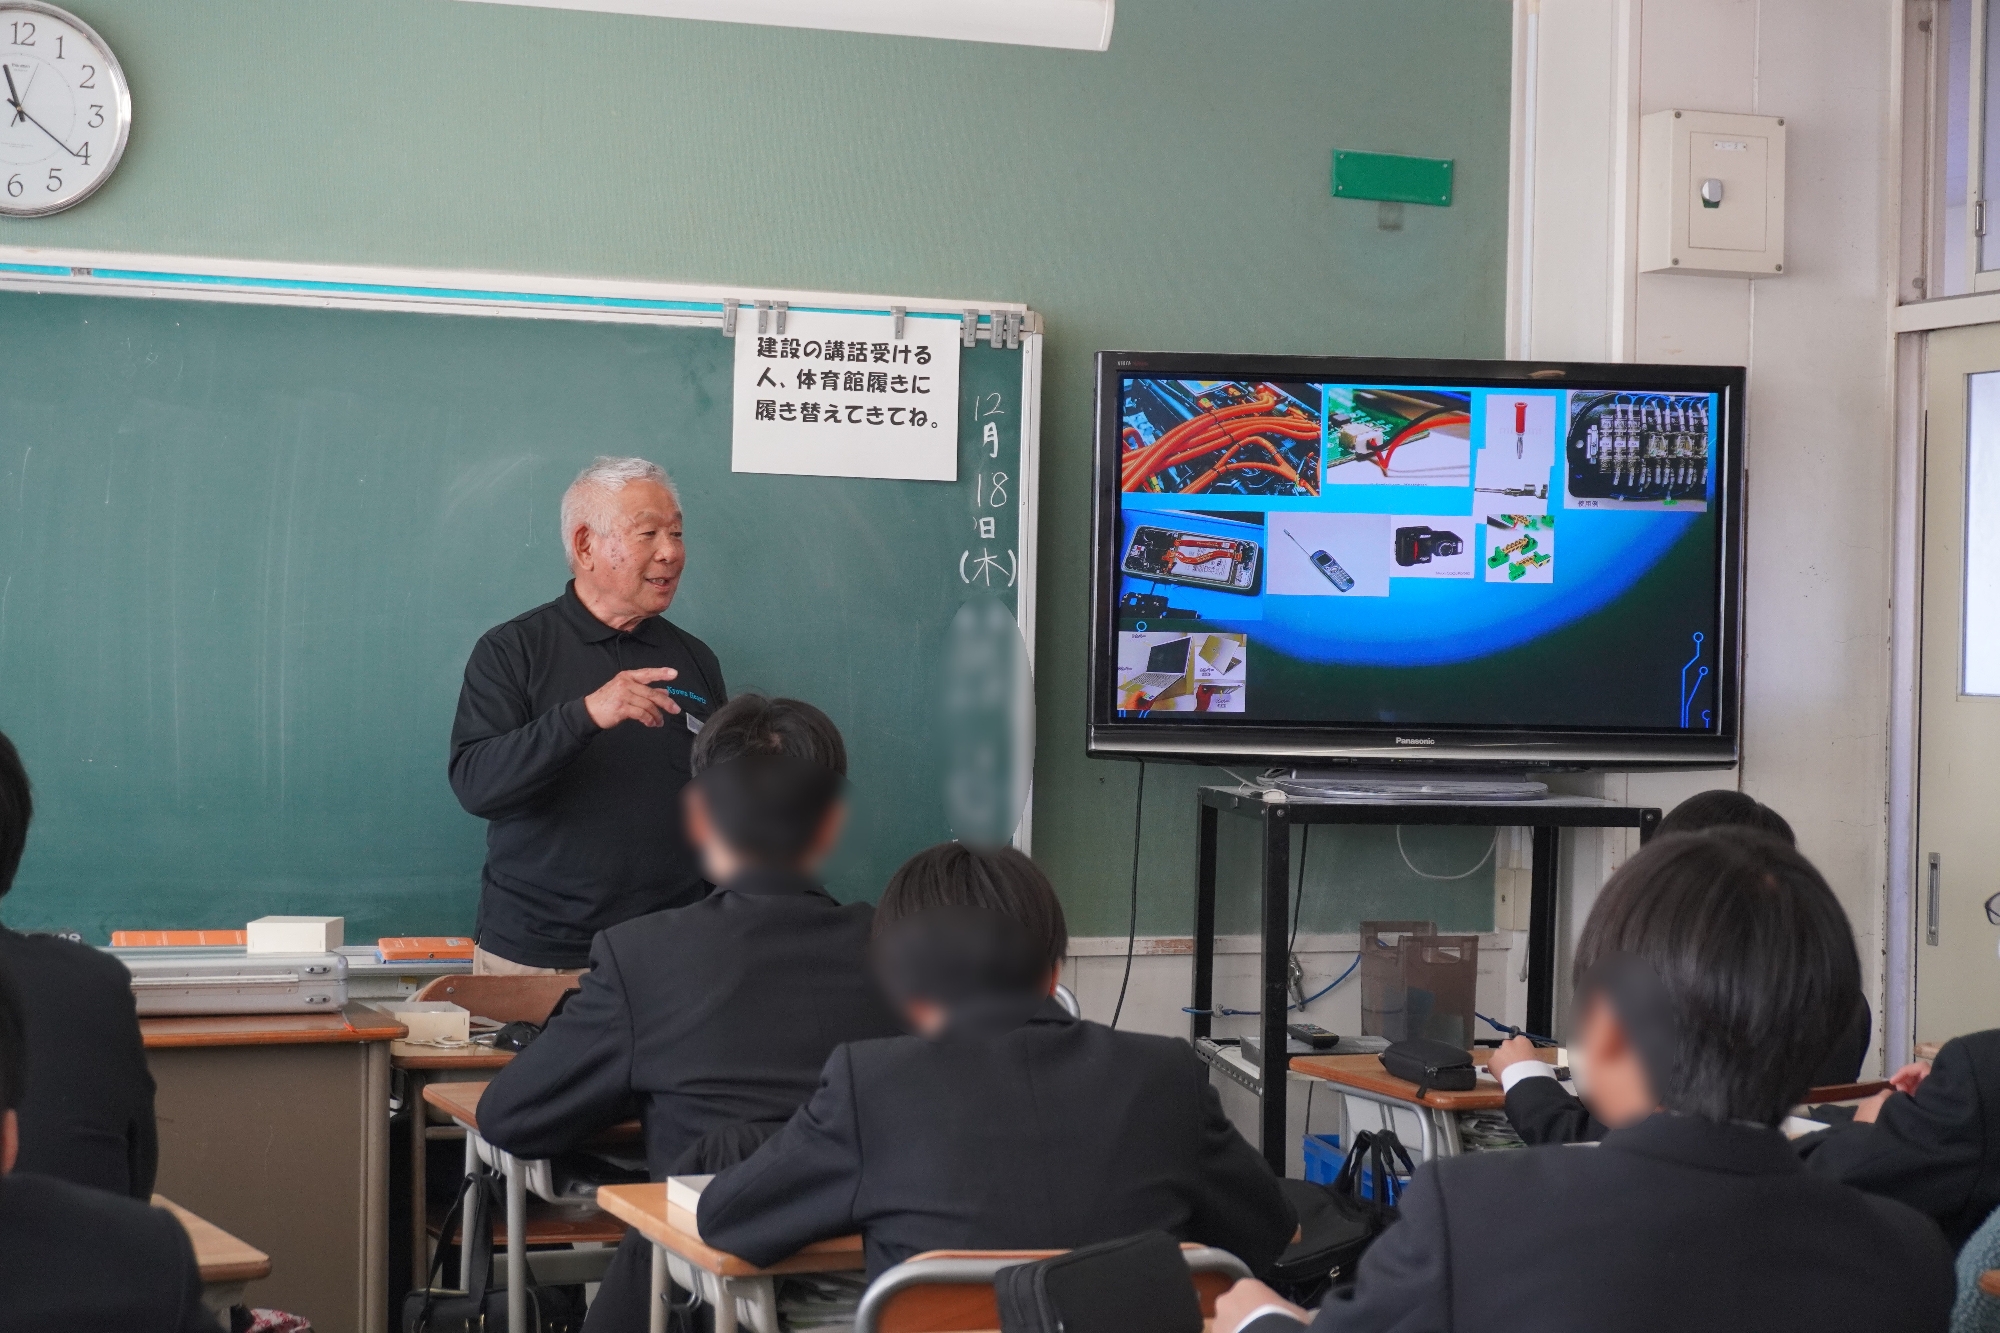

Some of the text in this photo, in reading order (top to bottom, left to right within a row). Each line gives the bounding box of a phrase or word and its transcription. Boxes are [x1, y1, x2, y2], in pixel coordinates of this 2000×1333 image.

[11, 21, 36, 46] 12
[55, 35, 65, 59] 1
[79, 64, 96, 89] 2
[87, 104, 104, 128] 3
[75, 141, 92, 166] 4
[7, 173, 24, 197] 6
[46, 168, 62, 192] 5
[757, 336, 932, 365] 建設の講話受ける
[756, 366, 931, 394] 人、体育館履きに
[755, 399, 938, 429] 履き替えてきてね。
[1395, 736, 1436, 745] Panasonic
